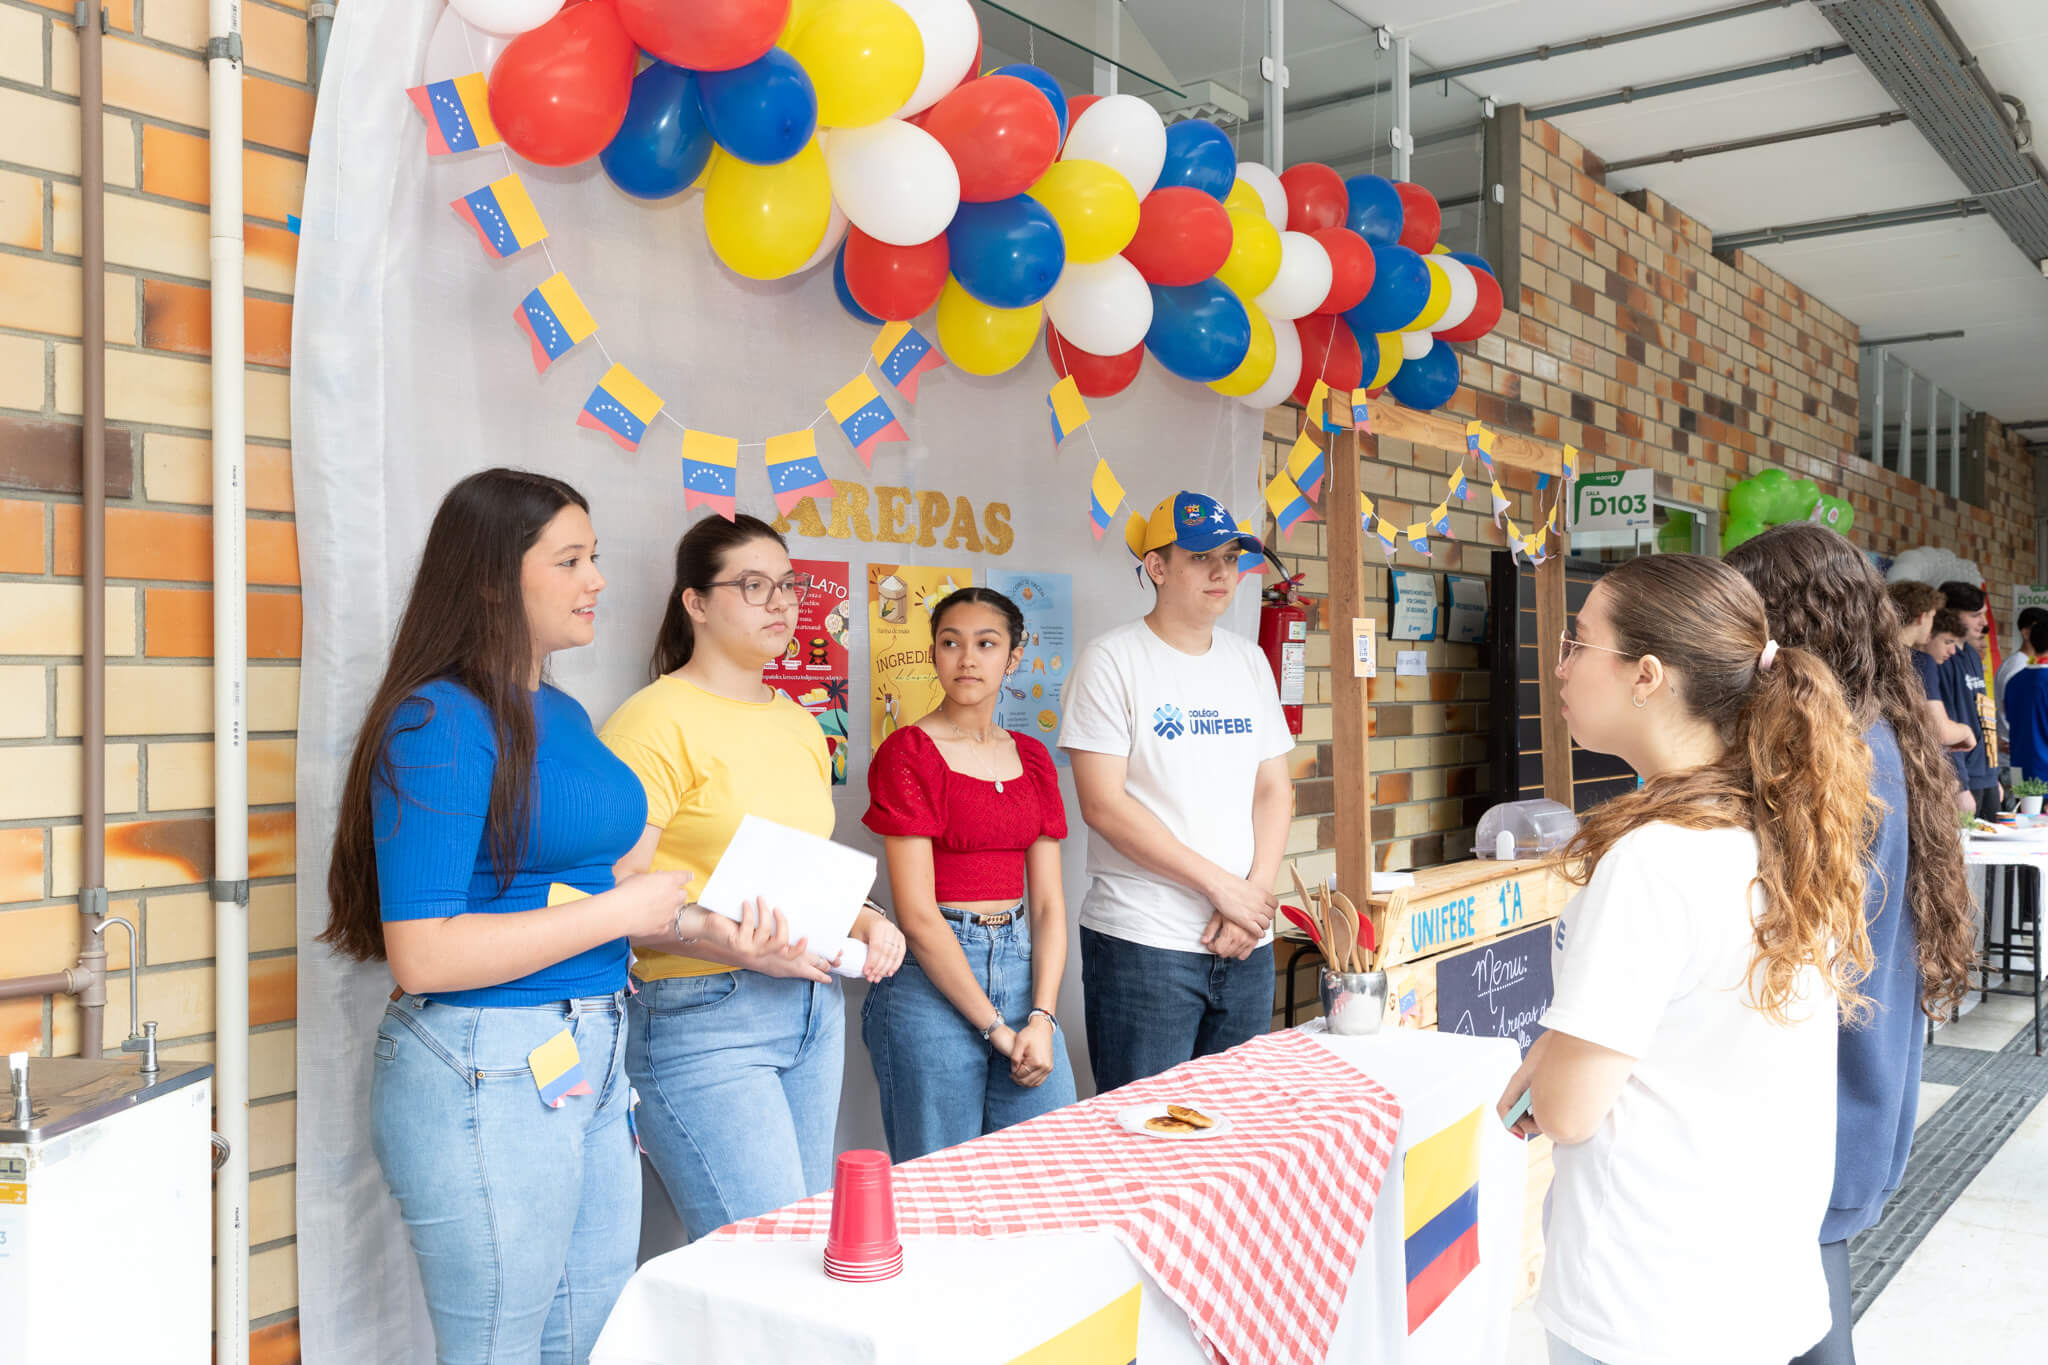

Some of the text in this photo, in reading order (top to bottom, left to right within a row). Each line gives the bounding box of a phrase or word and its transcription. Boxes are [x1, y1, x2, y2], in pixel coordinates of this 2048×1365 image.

[771, 479, 1014, 556] AREPAS
[1590, 494, 1646, 517] D103
[809, 574, 848, 599] LATO
[1188, 708, 1219, 718] COLÉGIO
[1190, 718, 1253, 735] UNIFEBE
[1411, 895, 1475, 953] UNIFEBE
[1554, 918, 1567, 951] E
[1472, 948, 1528, 1014] Menu:
